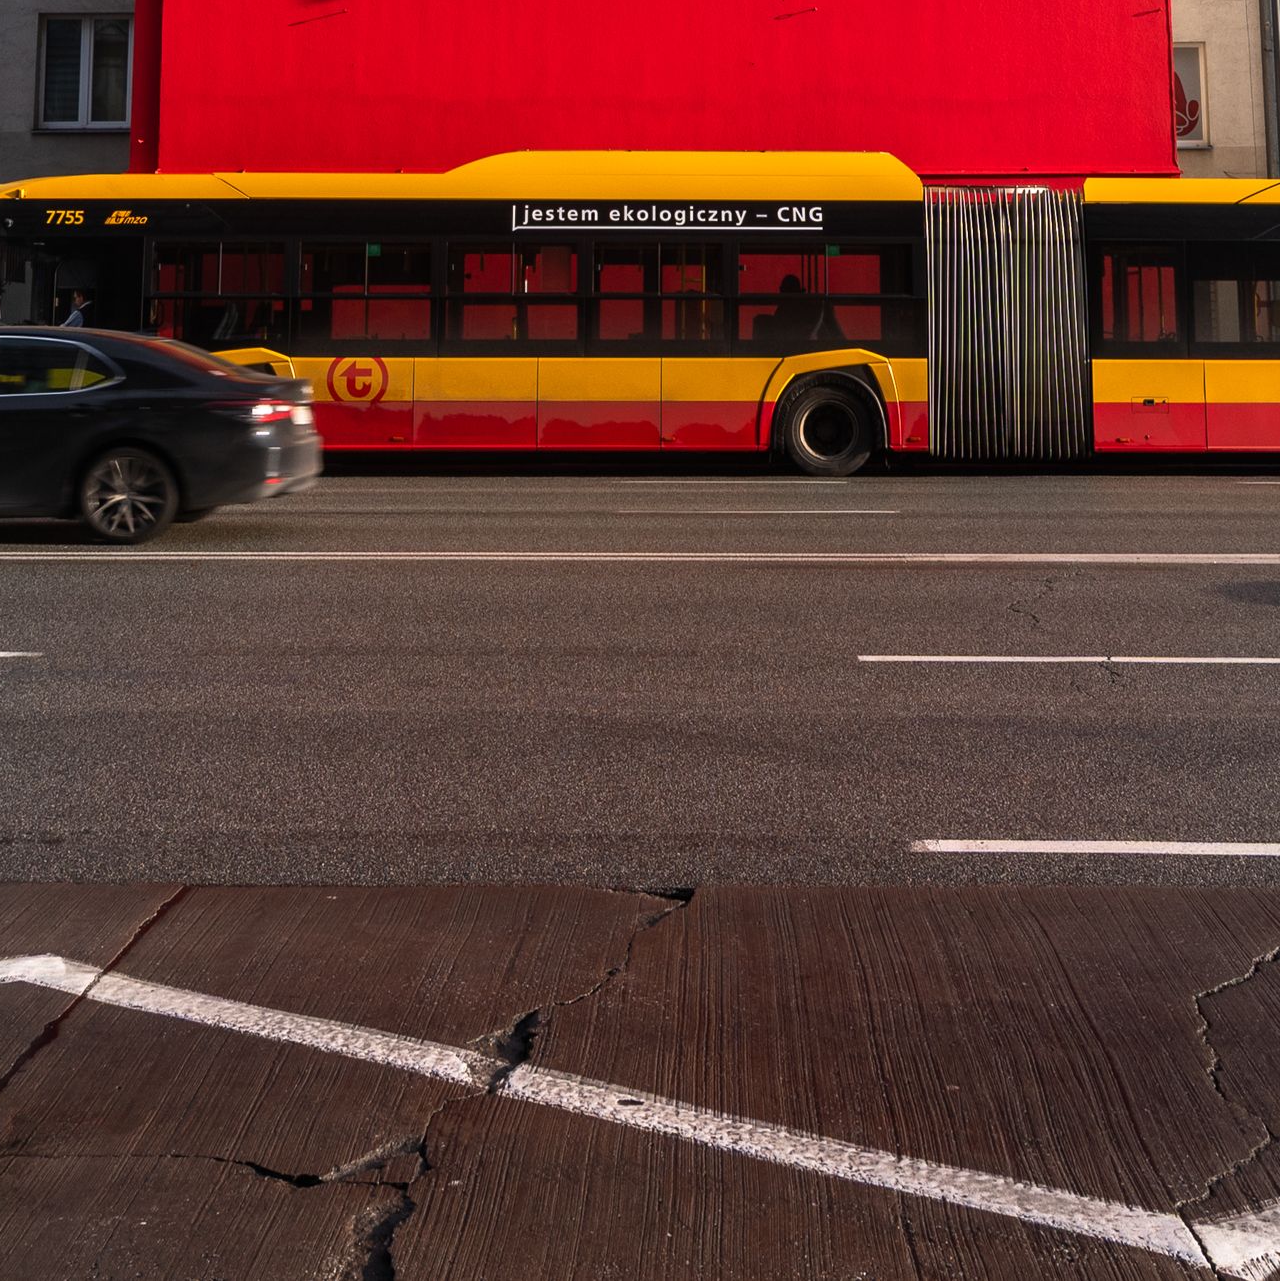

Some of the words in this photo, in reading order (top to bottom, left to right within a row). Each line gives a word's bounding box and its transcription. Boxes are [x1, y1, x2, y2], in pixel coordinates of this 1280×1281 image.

[46, 210, 85, 225] 7755
[523, 205, 598, 225] jestem
[609, 205, 747, 226] ekologiczny
[777, 206, 823, 222] CNG
